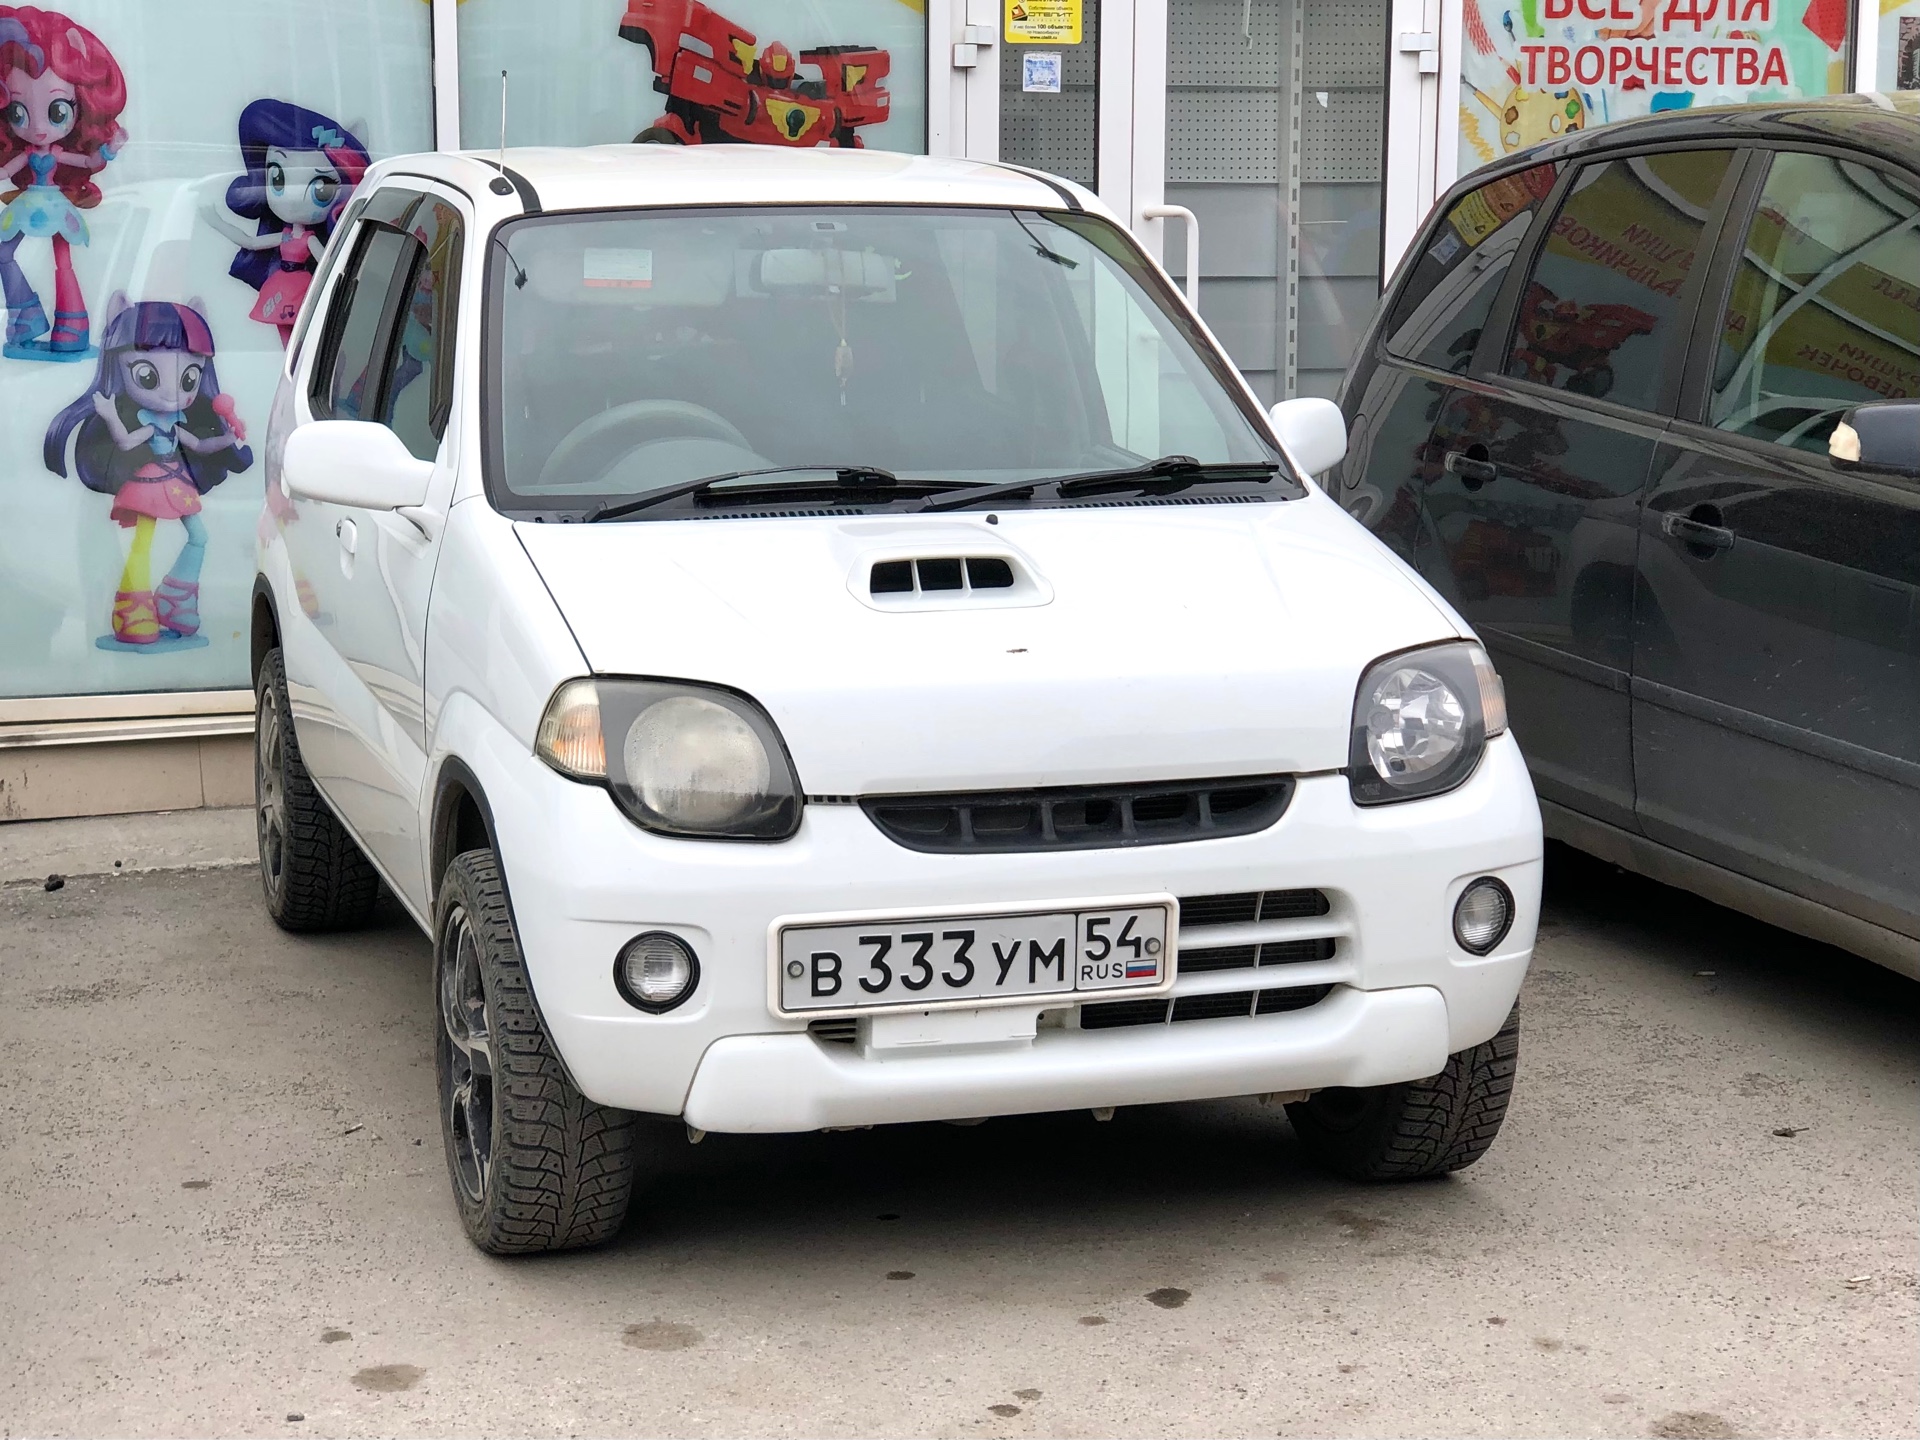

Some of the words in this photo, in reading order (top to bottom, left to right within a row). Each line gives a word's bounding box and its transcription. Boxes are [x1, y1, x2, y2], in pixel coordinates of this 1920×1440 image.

[1520, 45, 1789, 86] ТВОРЧЕСТВА
[858, 929, 976, 994] 333
[992, 936, 1065, 986] УМ
[1085, 915, 1142, 962] 54
[1081, 962, 1124, 981] RUS
